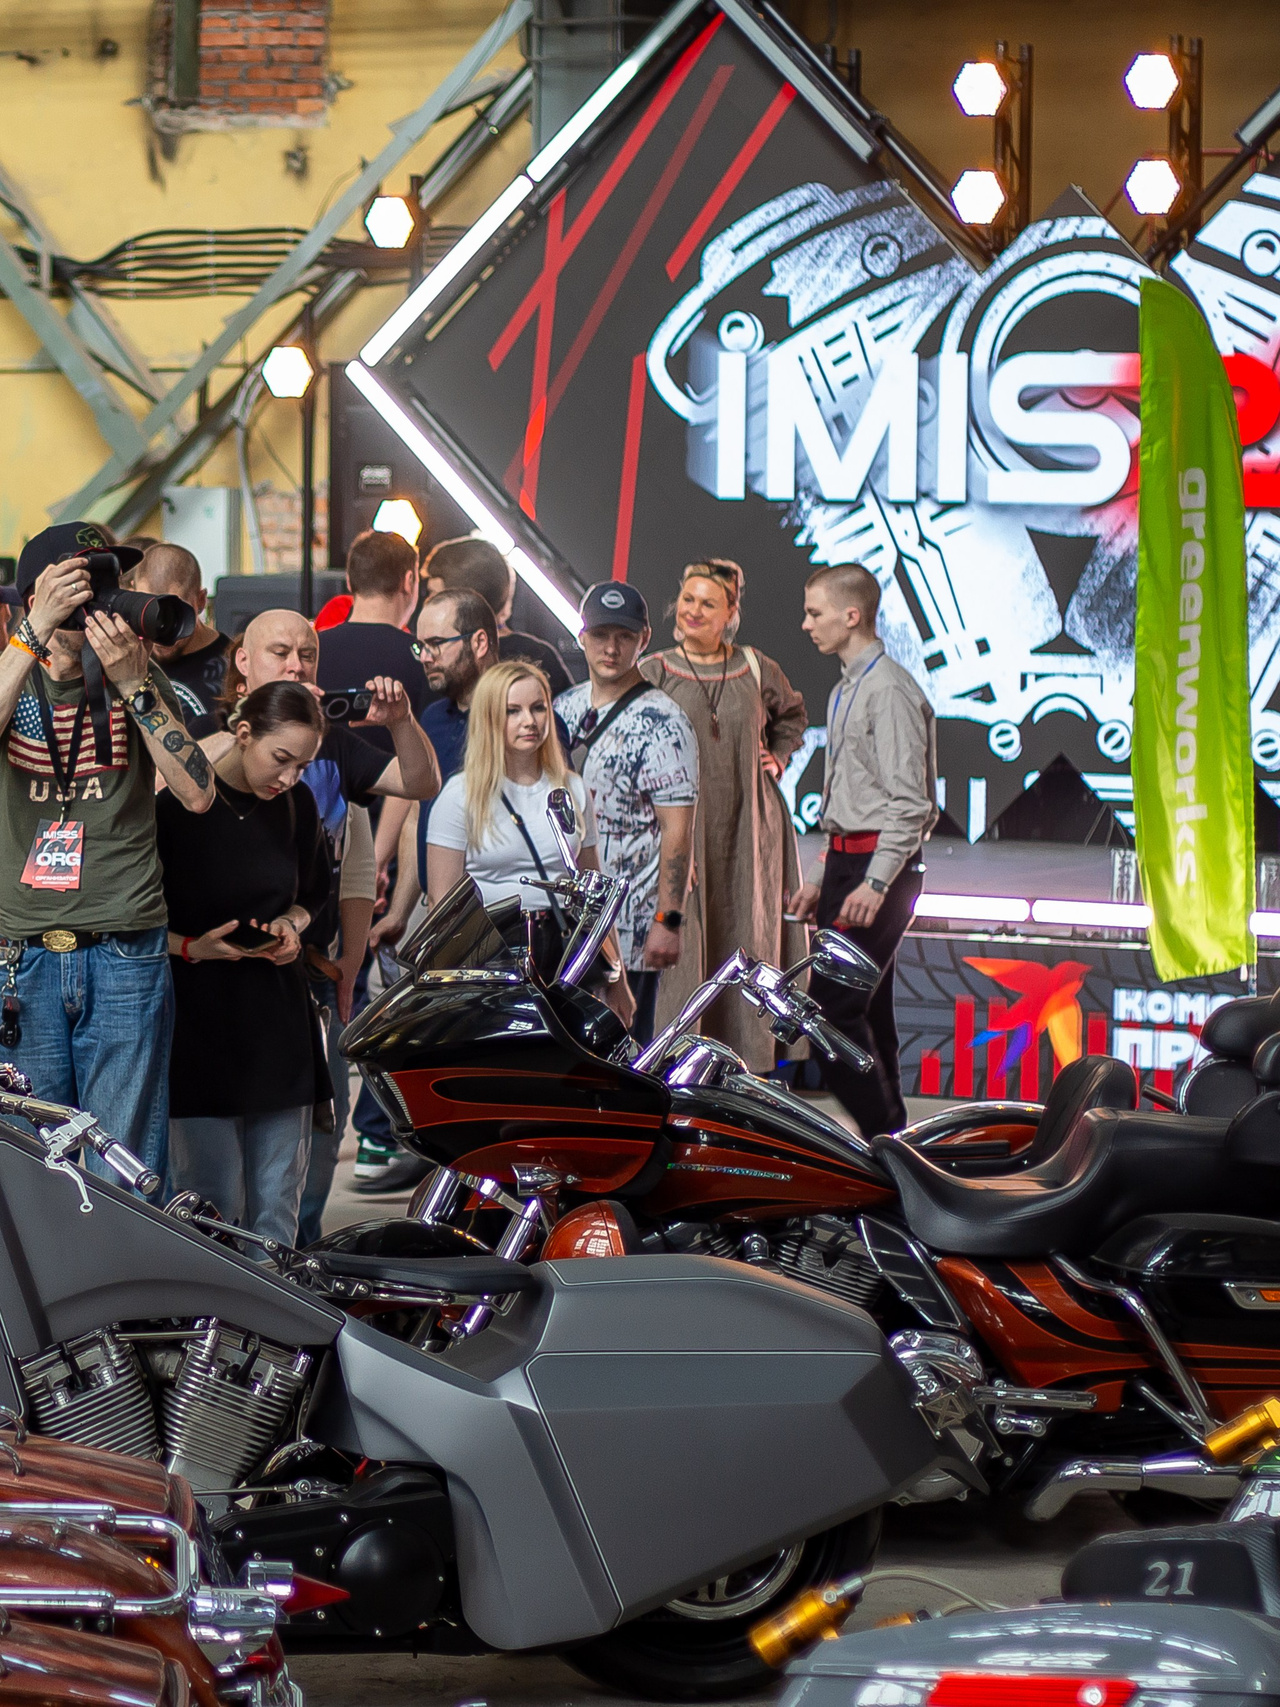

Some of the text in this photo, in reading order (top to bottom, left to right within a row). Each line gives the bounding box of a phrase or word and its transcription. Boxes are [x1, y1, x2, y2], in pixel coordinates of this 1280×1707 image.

[1174, 466, 1209, 886] greenworks
[29, 777, 104, 803] USA
[35, 852, 82, 867] ORG
[1113, 988, 1254, 1026] КОМ
[1144, 1561, 1195, 1597] 21
